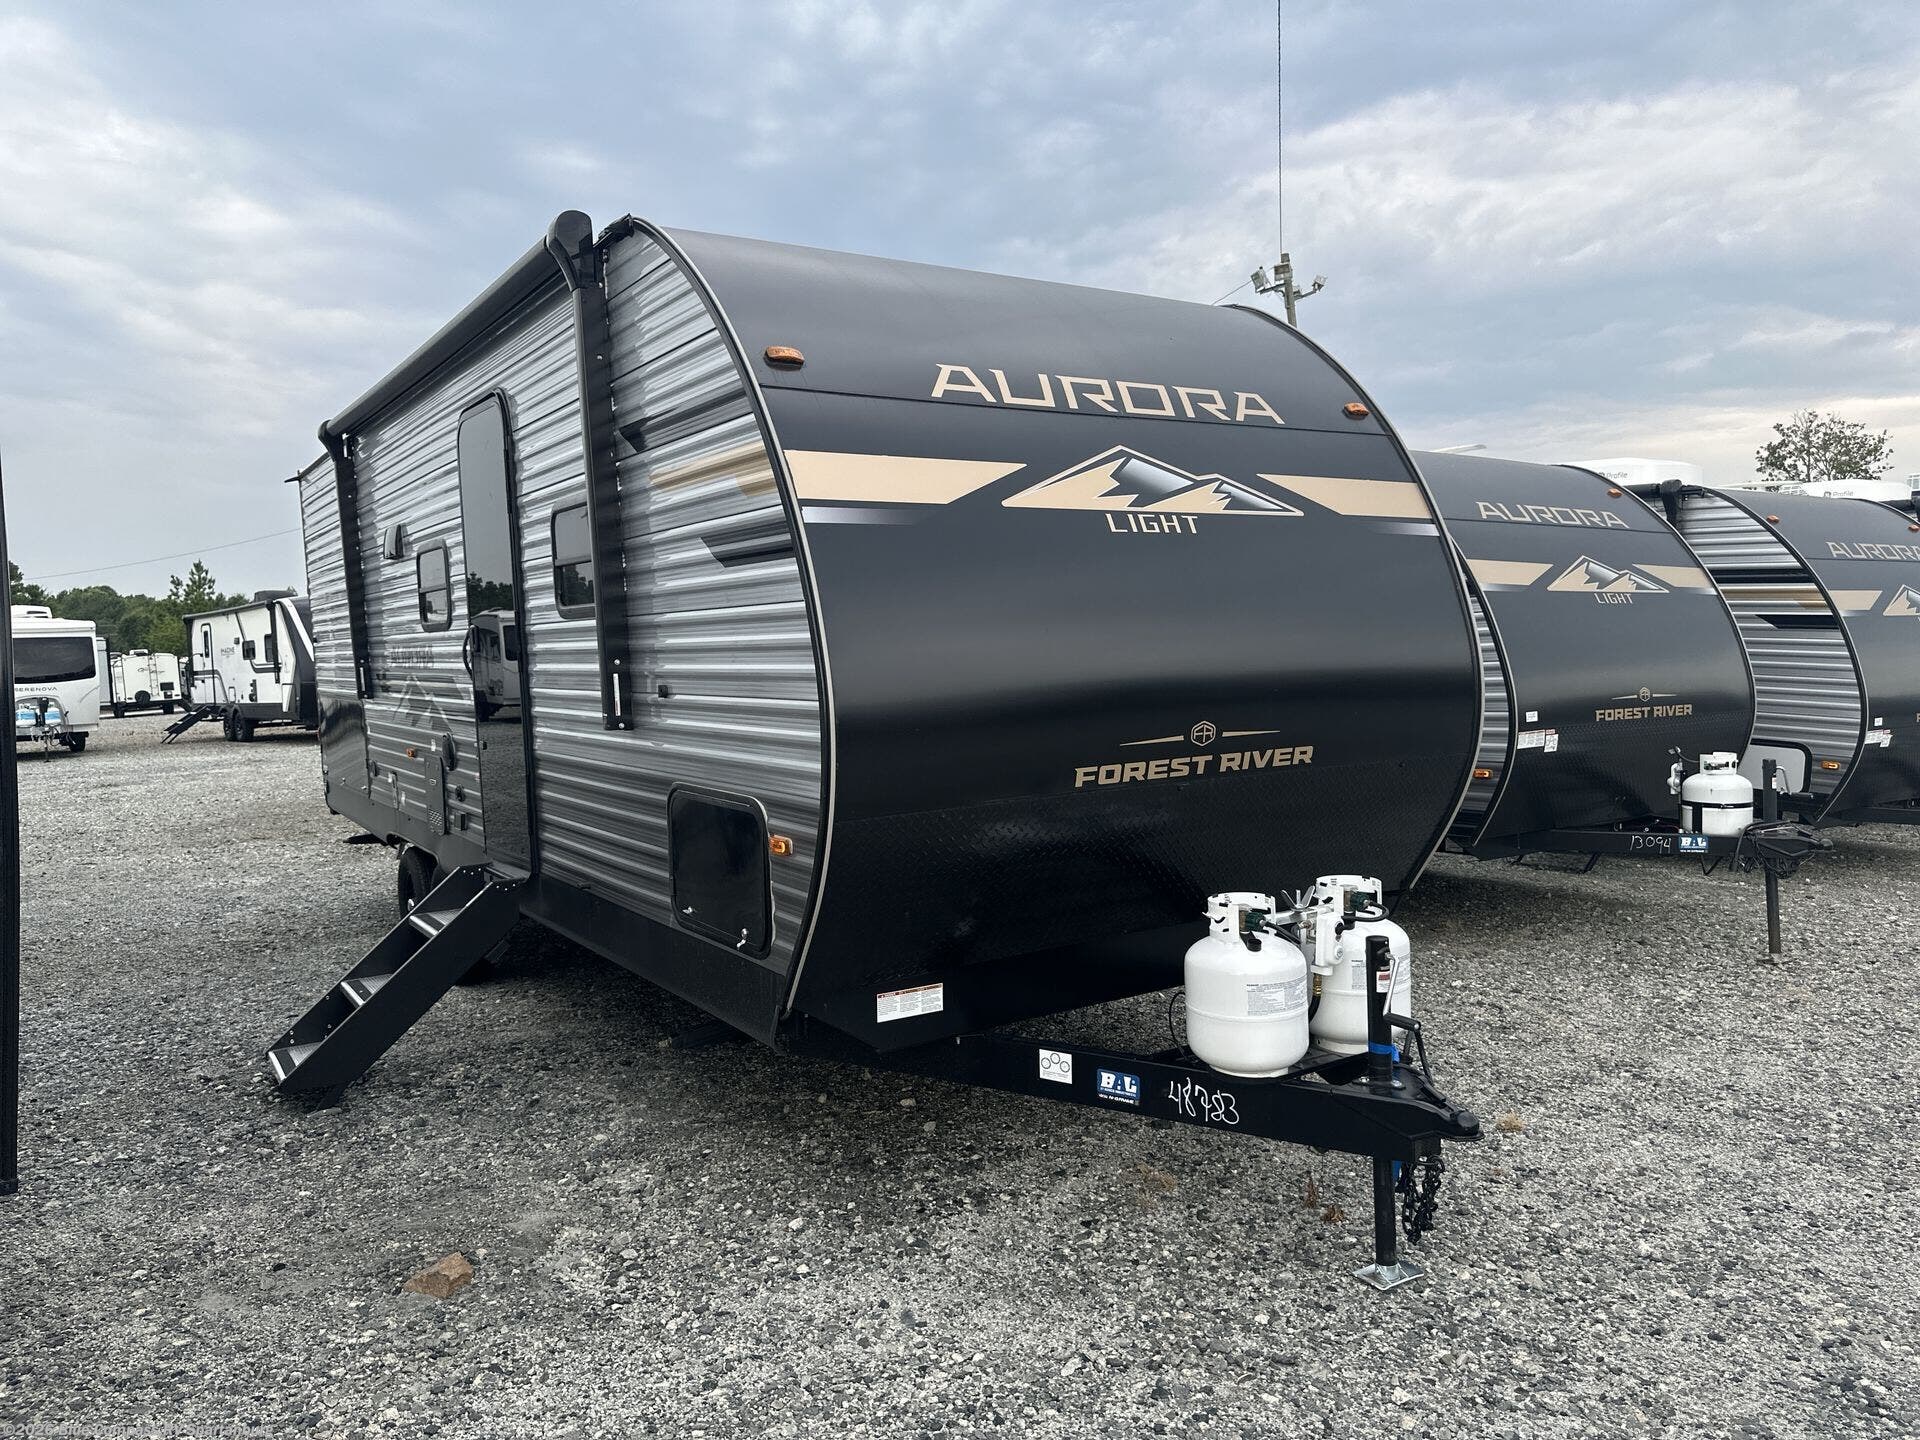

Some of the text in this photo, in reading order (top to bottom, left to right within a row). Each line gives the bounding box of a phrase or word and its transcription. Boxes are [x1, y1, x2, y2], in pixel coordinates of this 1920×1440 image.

[931, 363, 1285, 425] AURORA
[1105, 513, 1199, 534] LIGHT
[1476, 501, 1630, 529] AURORA
[1594, 592, 1634, 605] LIGHT
[1595, 704, 1693, 722] FOREST RIVER
[1074, 745, 1314, 788] FOREST RIVER
[1630, 835, 1672, 854] 13094
[1680, 837, 1707, 847] BAL
[1100, 1071, 1138, 1094] BAL
